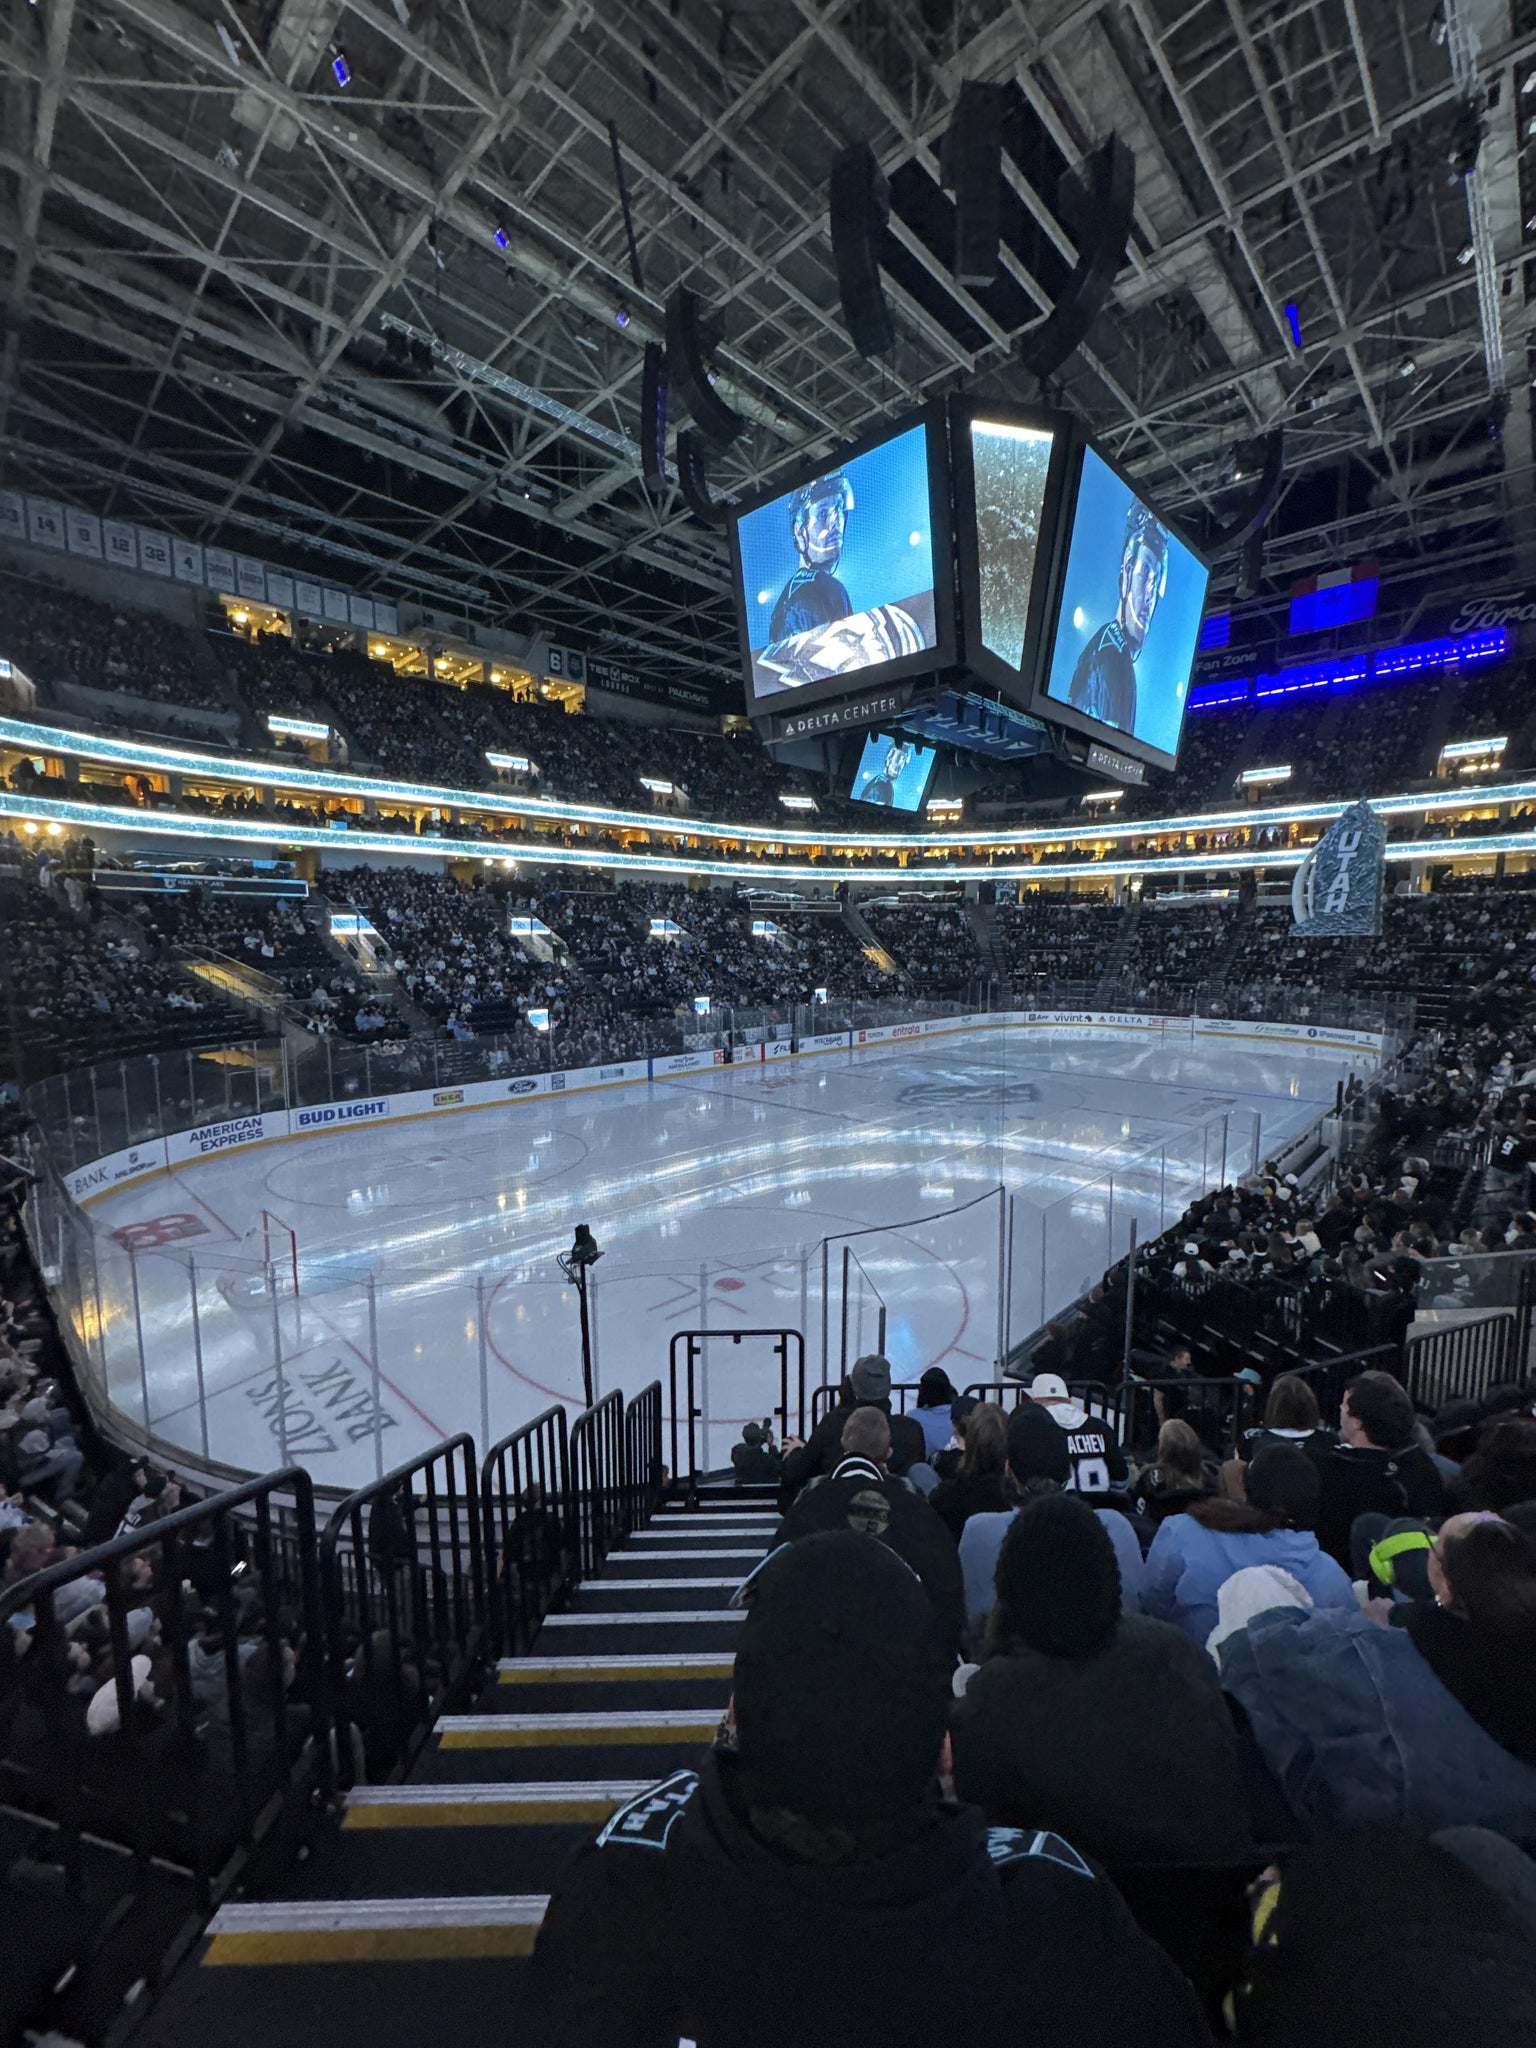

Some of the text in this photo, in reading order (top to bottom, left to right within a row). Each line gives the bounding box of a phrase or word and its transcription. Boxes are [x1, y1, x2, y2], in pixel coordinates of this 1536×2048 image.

[37, 516, 57, 534] 14
[112, 536, 130, 553] 12
[145, 545, 166, 562] 32
[550, 653, 561, 671] 6
[1195, 652, 1258, 672] Fan Zone
[589, 663, 641, 685] TEE BOX
[797, 698, 896, 732] DELTA CENTER
[1324, 830, 1362, 914] UTAH
[892, 1025, 920, 1037] entrata
[1109, 1015, 1143, 1024] DELTA
[299, 1101, 387, 1126] BUD LIGHT
[189, 1117, 263, 1144] AMERICAN
[200, 1127, 264, 1152] EXPRESS
[74, 1166, 109, 1196] BANK
[299, 1358, 400, 1445] BANK
[245, 1377, 339, 1468] ZIONS
[1067, 1433, 1106, 1454] ACHEV
[621, 1781, 700, 1831] TAH
